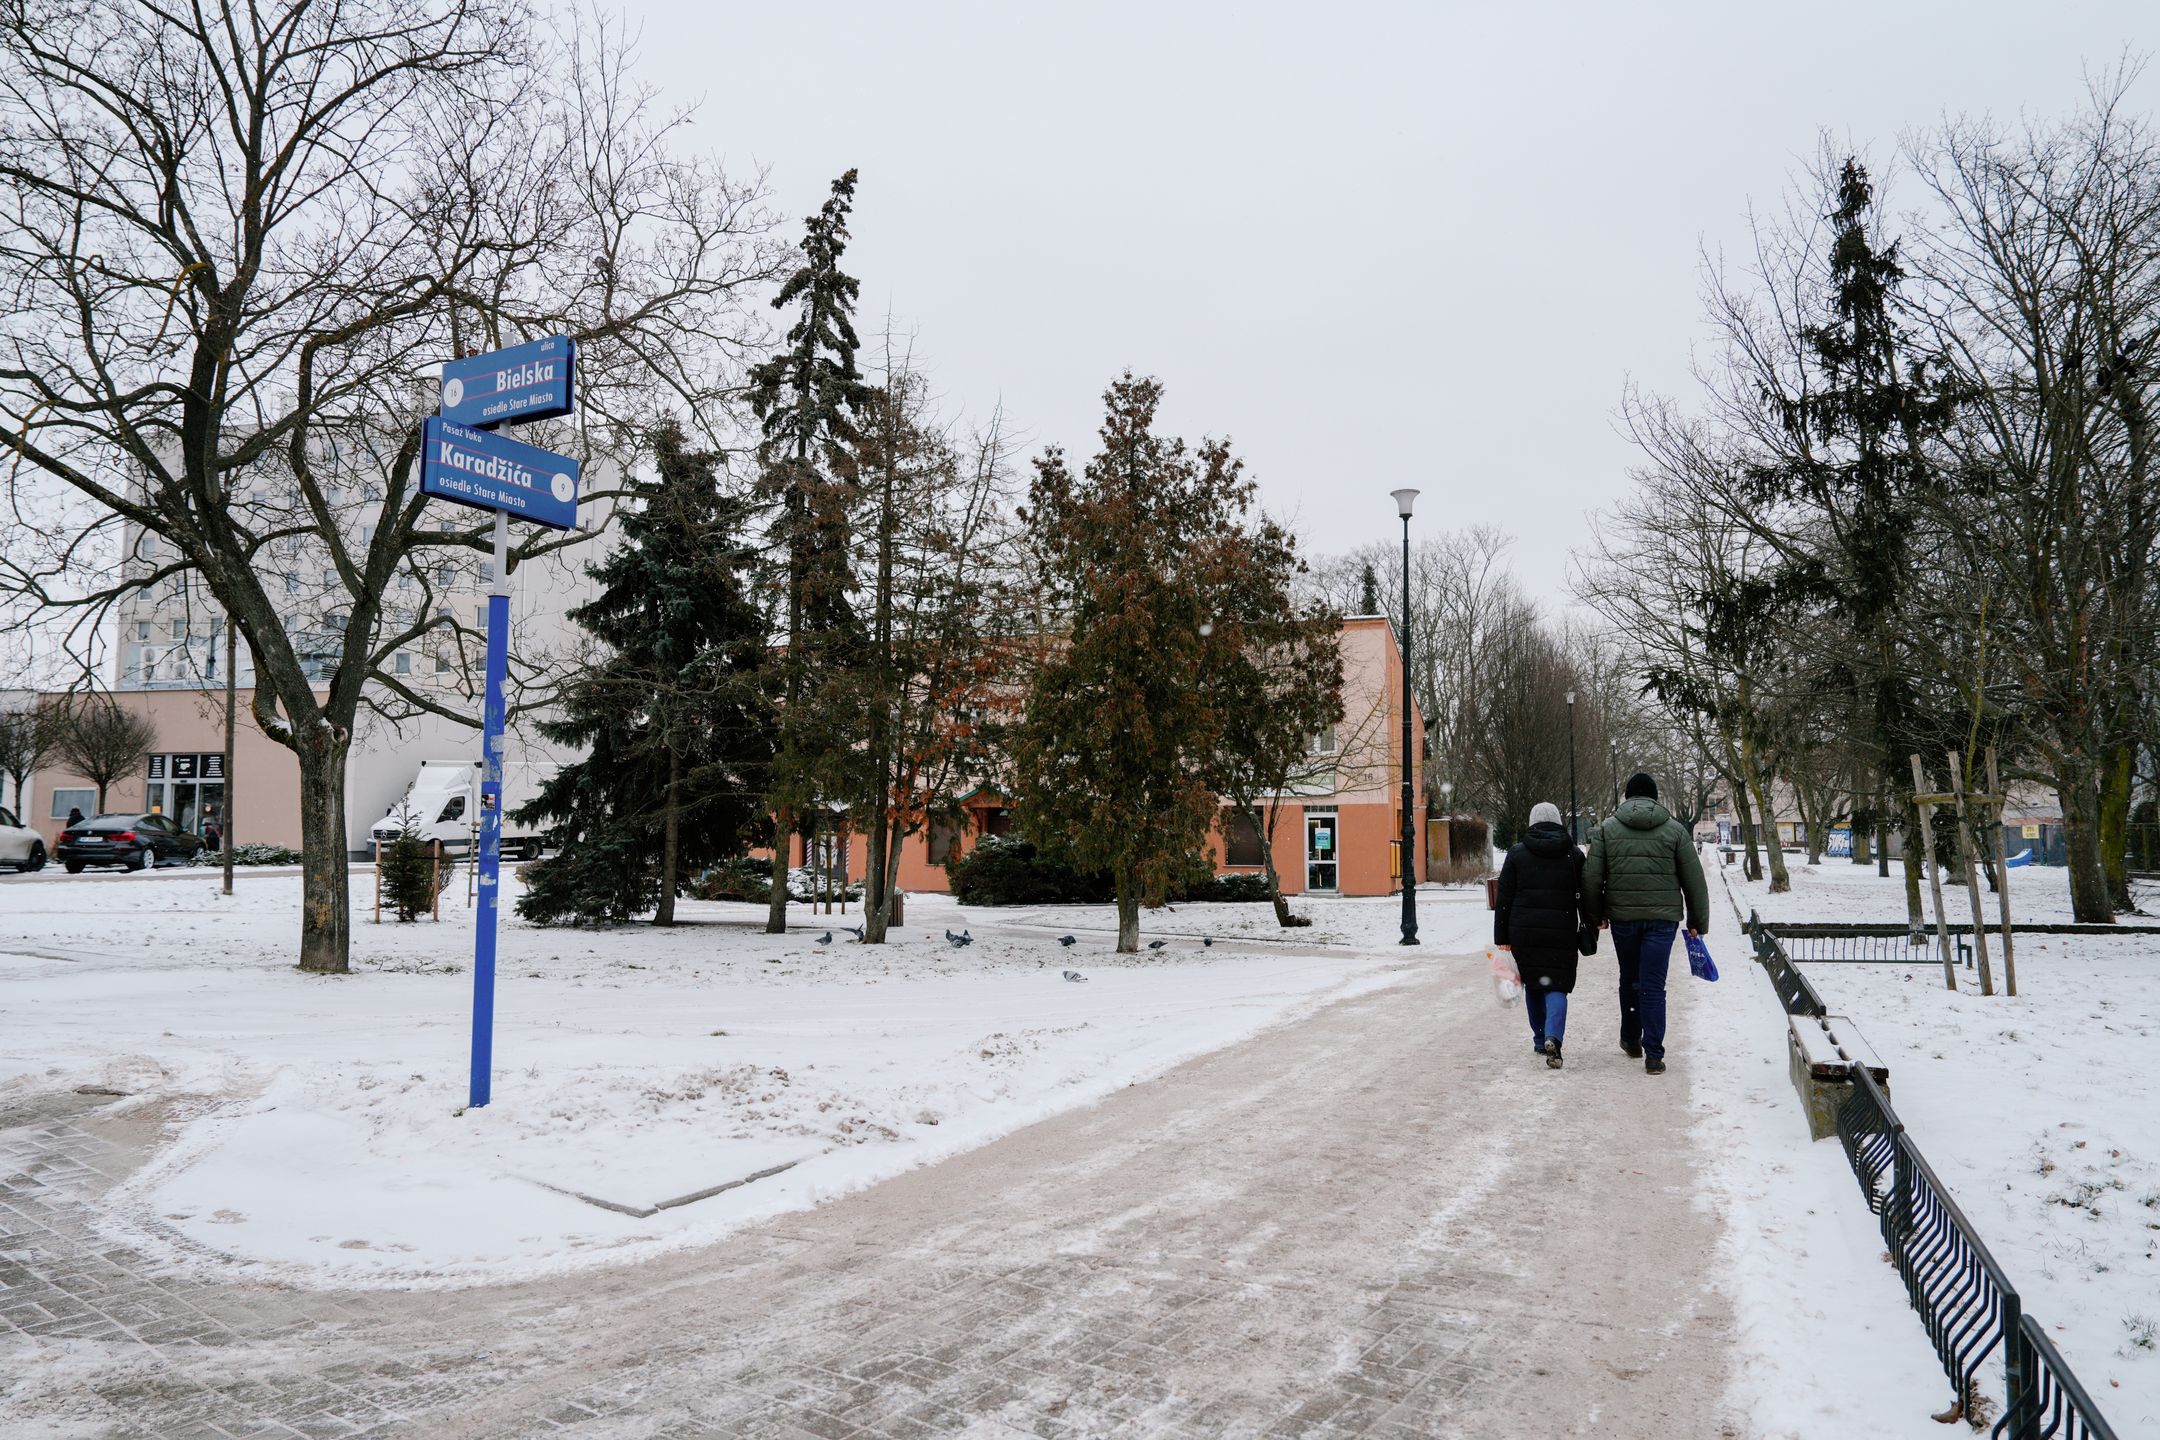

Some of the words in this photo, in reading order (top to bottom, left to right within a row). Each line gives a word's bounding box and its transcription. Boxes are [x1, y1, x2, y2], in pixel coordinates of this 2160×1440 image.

[541, 342, 554, 351] ulica
[496, 361, 554, 392] Bielska
[483, 403, 508, 416] osiedle
[509, 399, 528, 411] Stare
[529, 392, 553, 406] Miasto
[442, 422, 463, 437] Pasaż
[465, 429, 482, 443] Vuka
[440, 441, 532, 489] Karadžića
[440, 477, 472, 493] osiedle
[474, 485, 496, 500] Stare
[498, 490, 526, 508] Miasto
[1363, 773, 1374, 781] 16
